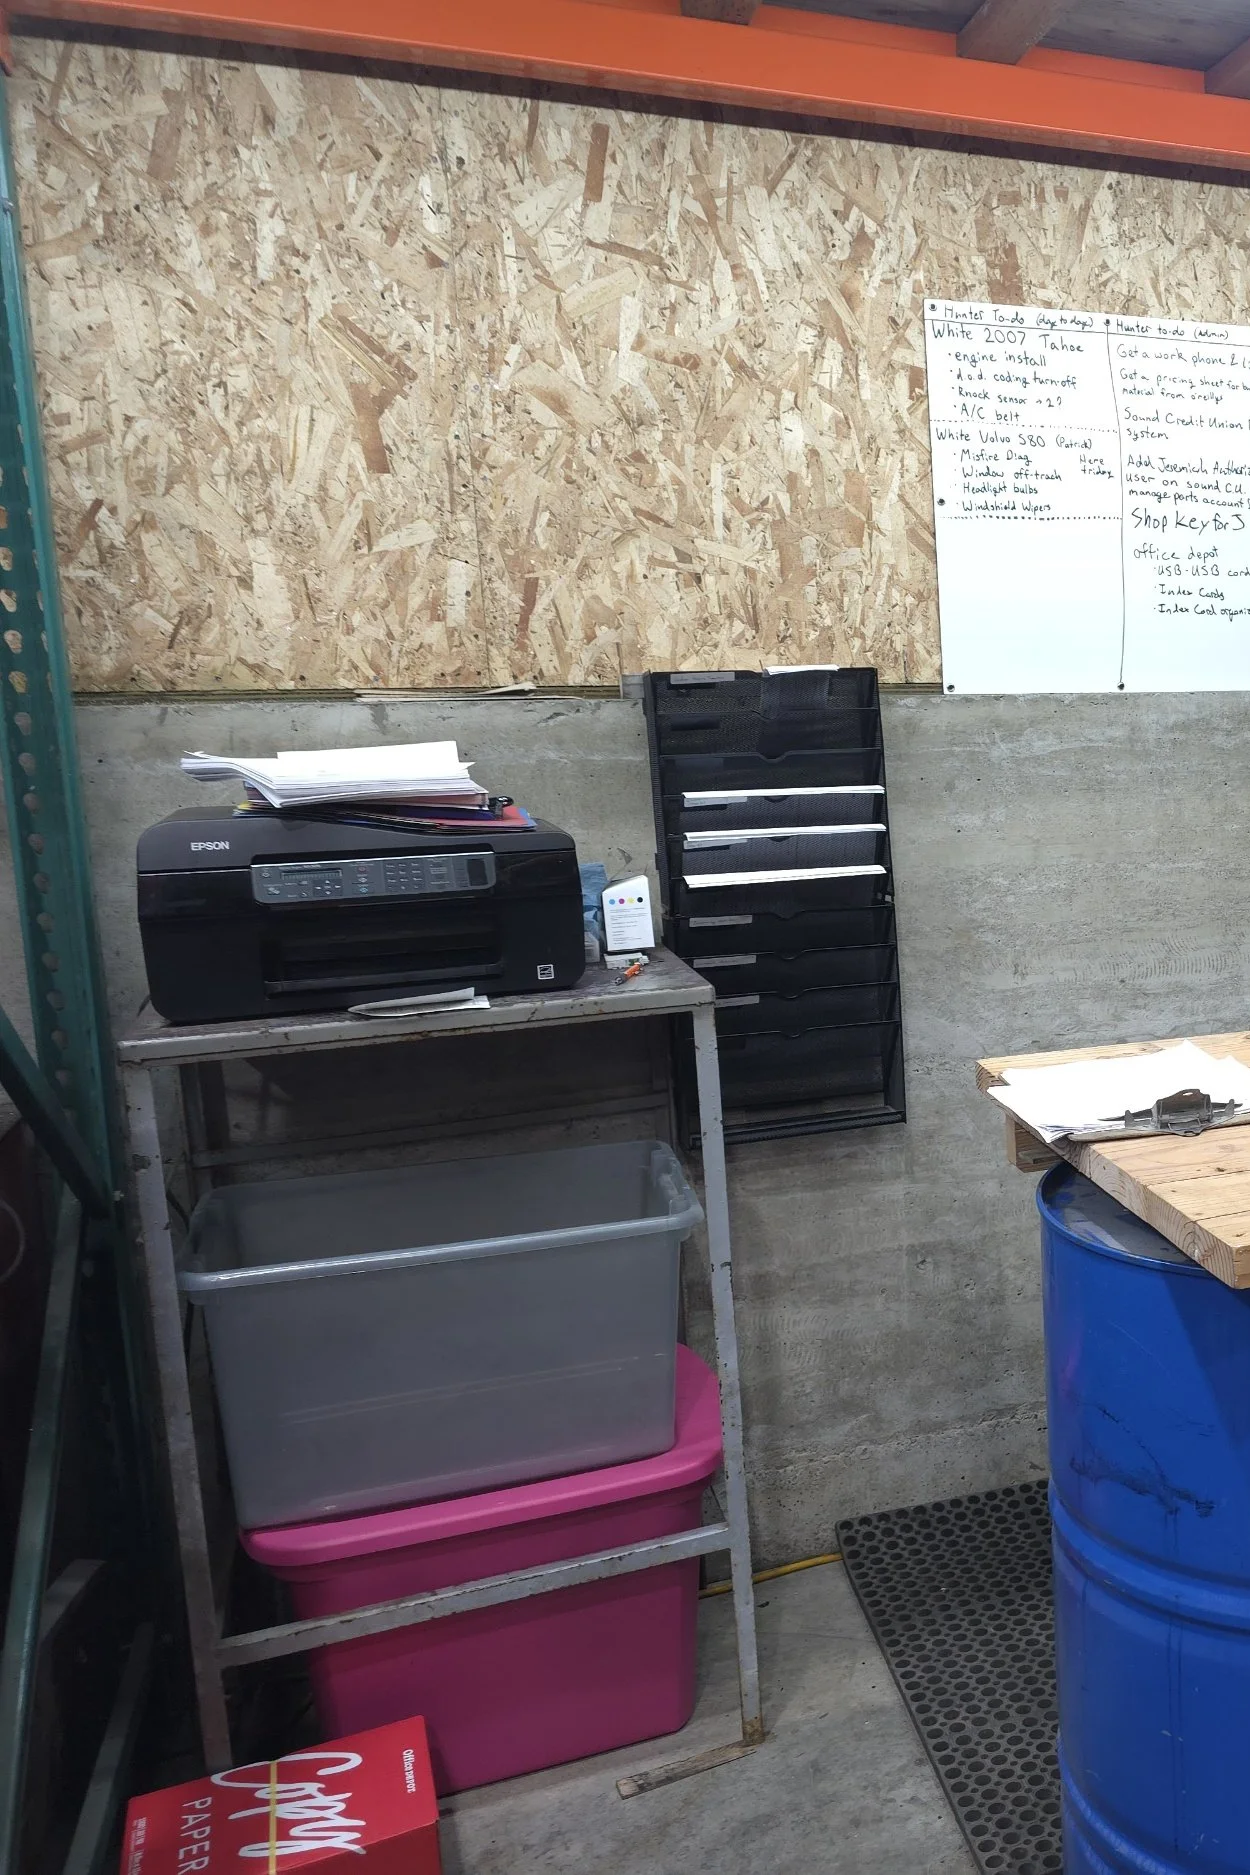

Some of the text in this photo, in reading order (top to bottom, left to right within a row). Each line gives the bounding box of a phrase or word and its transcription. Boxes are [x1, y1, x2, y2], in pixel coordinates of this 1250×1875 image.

[945, 305, 984, 320] Hunter
[993, 309, 1024, 324] To-do
[1116, 319, 1184, 336] Hunter to-do
[932, 320, 1084, 352] White 2007 Tahoe
[956, 352, 1046, 367] engine install
[1117, 344, 1138, 357] Get
[1154, 348, 1187, 362] work
[1192, 352, 1225, 366] phone
[994, 372, 1030, 388] coding
[1120, 368, 1138, 380] Get
[1157, 375, 1196, 389] pricing
[1200, 377, 1223, 387] sheet
[1227, 380, 1239, 390] for
[998, 395, 1027, 405] sensor
[1123, 387, 1184, 399] material from
[961, 404, 1019, 422] A/C belt
[1124, 407, 1243, 430] Sound Credit Union
[936, 428, 1092, 449] White Volvo S80 (Patrick)
[961, 449, 1032, 465] Misfire Diag
[962, 466, 1004, 478] Window
[963, 481, 1038, 496] Headlight bulbs
[1187, 480, 1221, 493] sound
[1129, 490, 1170, 503] manage
[1174, 492, 1198, 504] parts
[1203, 498, 1243, 508] account
[1022, 502, 1050, 515] Wipers
[1131, 507, 1168, 533] Shop
[1212, 513, 1228, 531] for
[1188, 546, 1218, 563] depot
[1228, 567, 1250, 577] cord
[1159, 584, 1225, 600] Index Cards
[1158, 603, 1189, 614] Index
[191, 841, 230, 851] EPSON
[210, 1751, 367, 1857] Copy
[177, 1797, 212, 1875] PAPER
